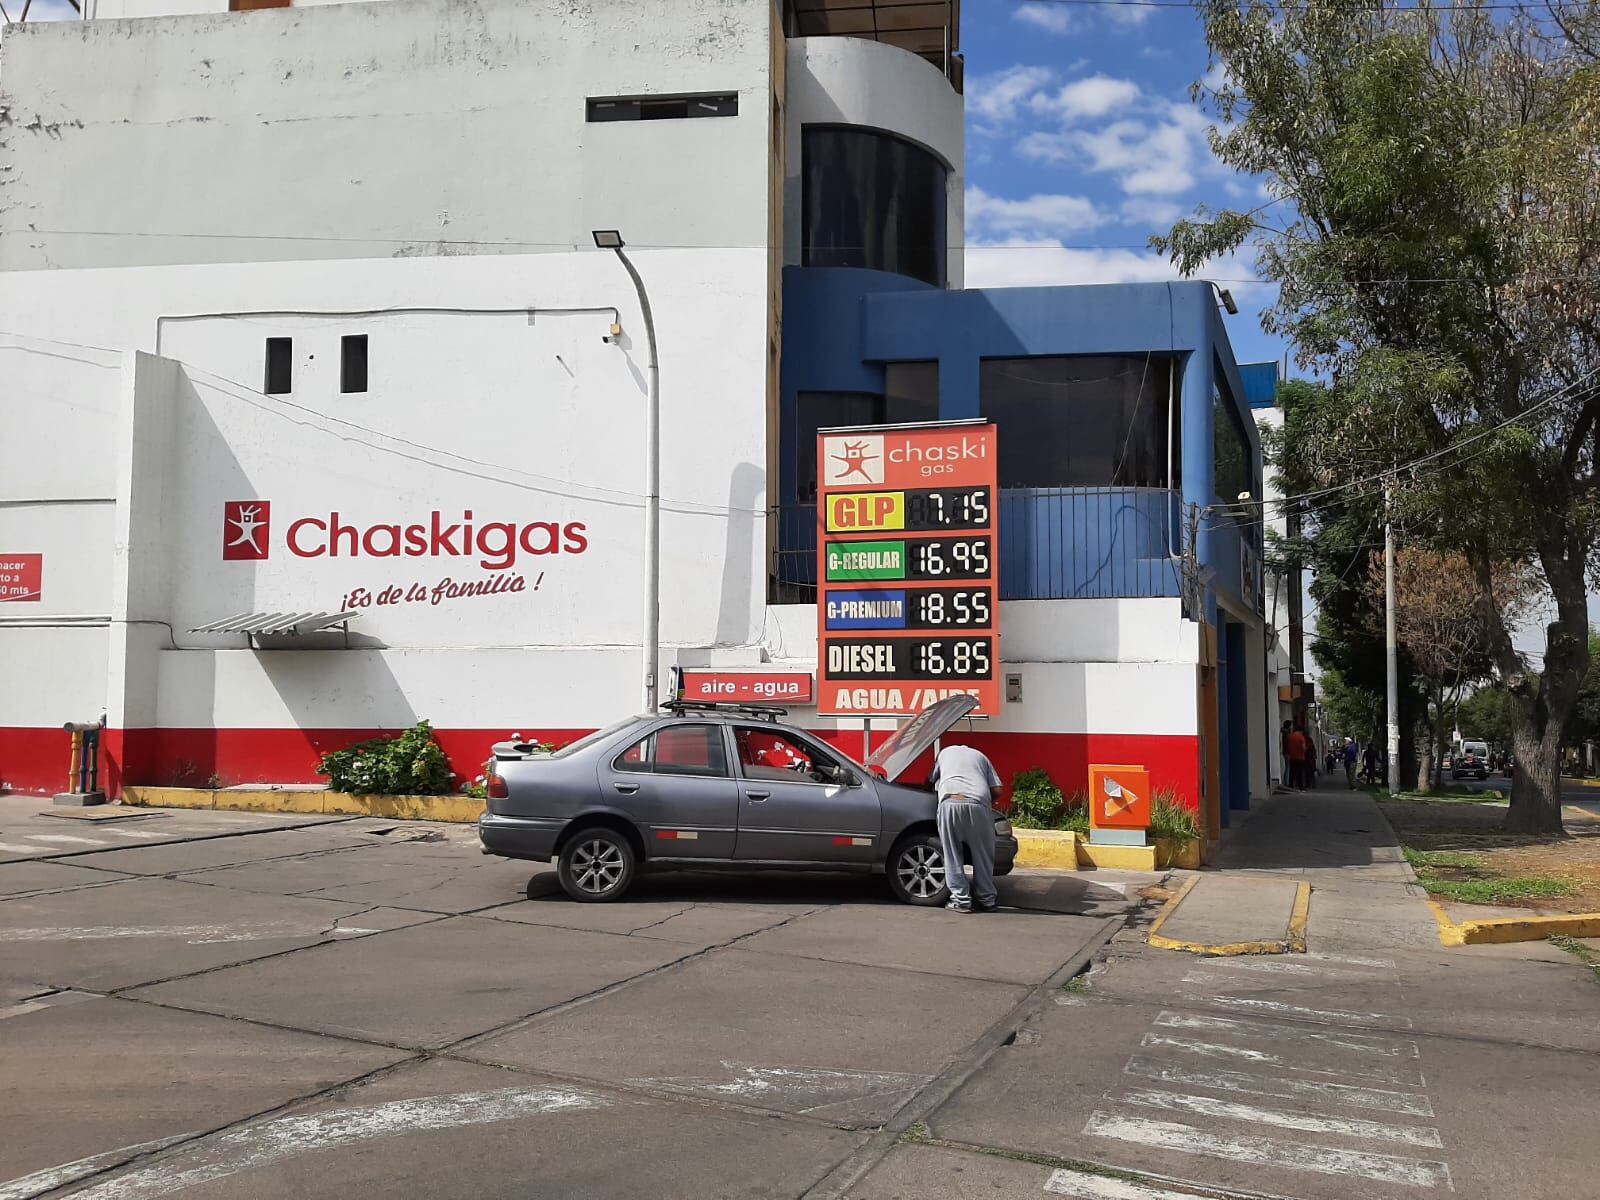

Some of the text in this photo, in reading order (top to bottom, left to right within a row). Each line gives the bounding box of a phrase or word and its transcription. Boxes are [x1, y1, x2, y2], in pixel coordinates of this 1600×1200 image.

[889, 436, 986, 463] chaski
[920, 464, 954, 477] gas
[833, 491, 988, 528] GLP 7.15
[286, 510, 588, 570] Chaskigas
[829, 541, 989, 575] G-REGULAR 16.95
[0, 585, 29, 595] 0 mts
[376, 584, 403, 606] de
[405, 582, 428, 602] la
[431, 572, 526, 606] familia
[827, 592, 989, 624] G-PREMIUM 18.55
[828, 641, 989, 674] DIESEL 16.85
[701, 679, 736, 694] aire
[753, 682, 799, 697] agua
[834, 688, 904, 710] AGUA
